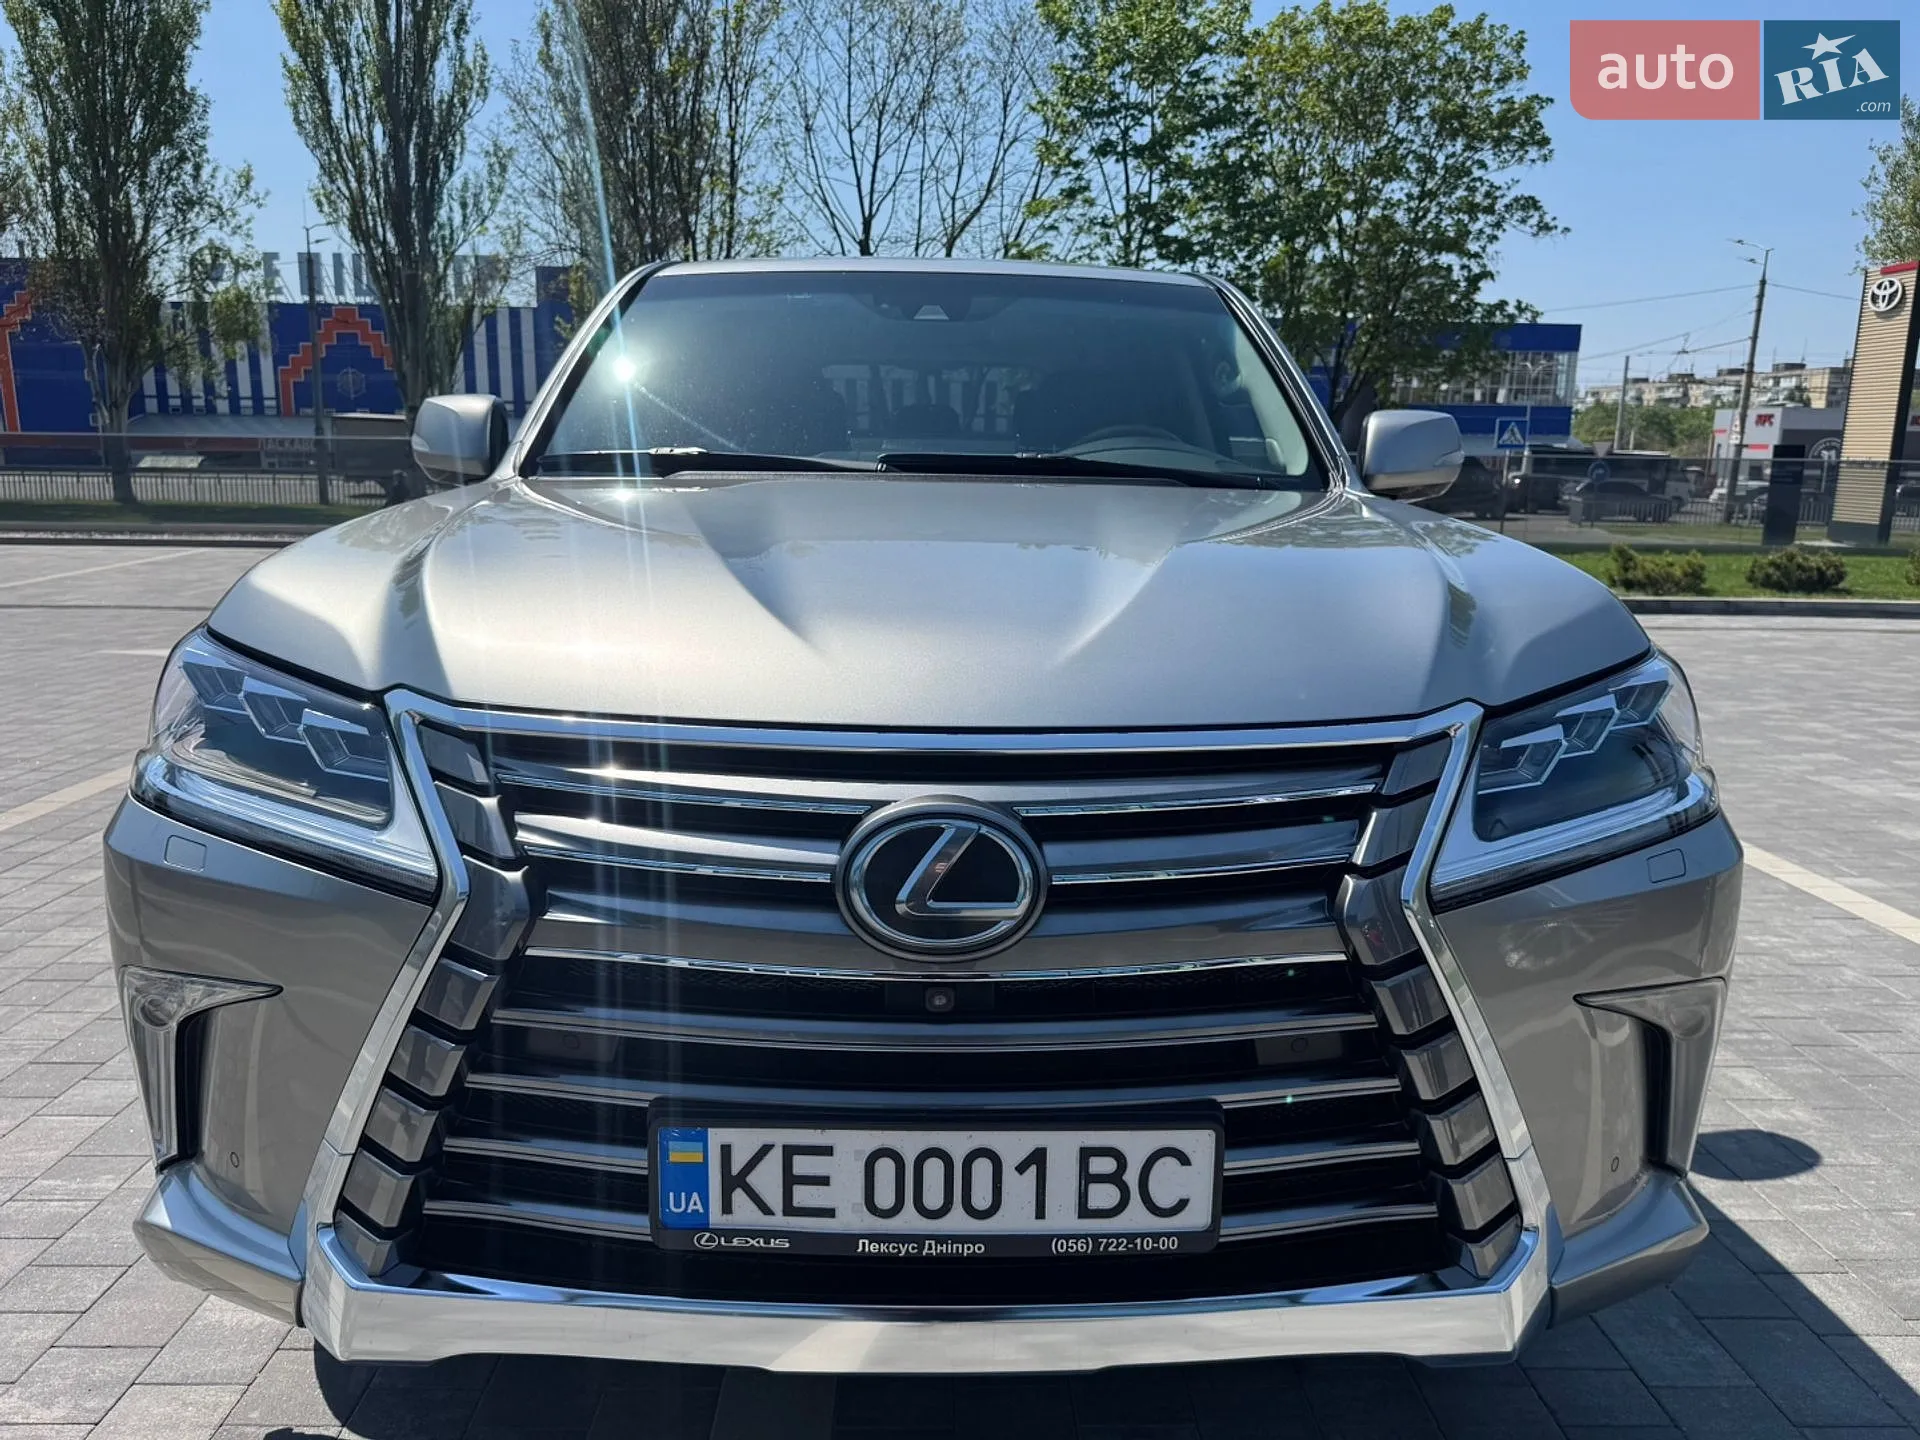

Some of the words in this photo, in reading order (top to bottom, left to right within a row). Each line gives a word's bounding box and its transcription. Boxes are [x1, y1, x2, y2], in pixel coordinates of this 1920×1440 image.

[719, 1143, 836, 1218] KE
[864, 1146, 1048, 1220] 0001
[1077, 1146, 1192, 1219] BC
[669, 1191, 704, 1213] UA
[721, 1236, 790, 1248] LEXUS
[856, 1238, 919, 1256] Лексус
[922, 1238, 985, 1256] Дніпро
[1050, 1236, 1092, 1254] (056)
[1097, 1236, 1178, 1253] 722-10-00
